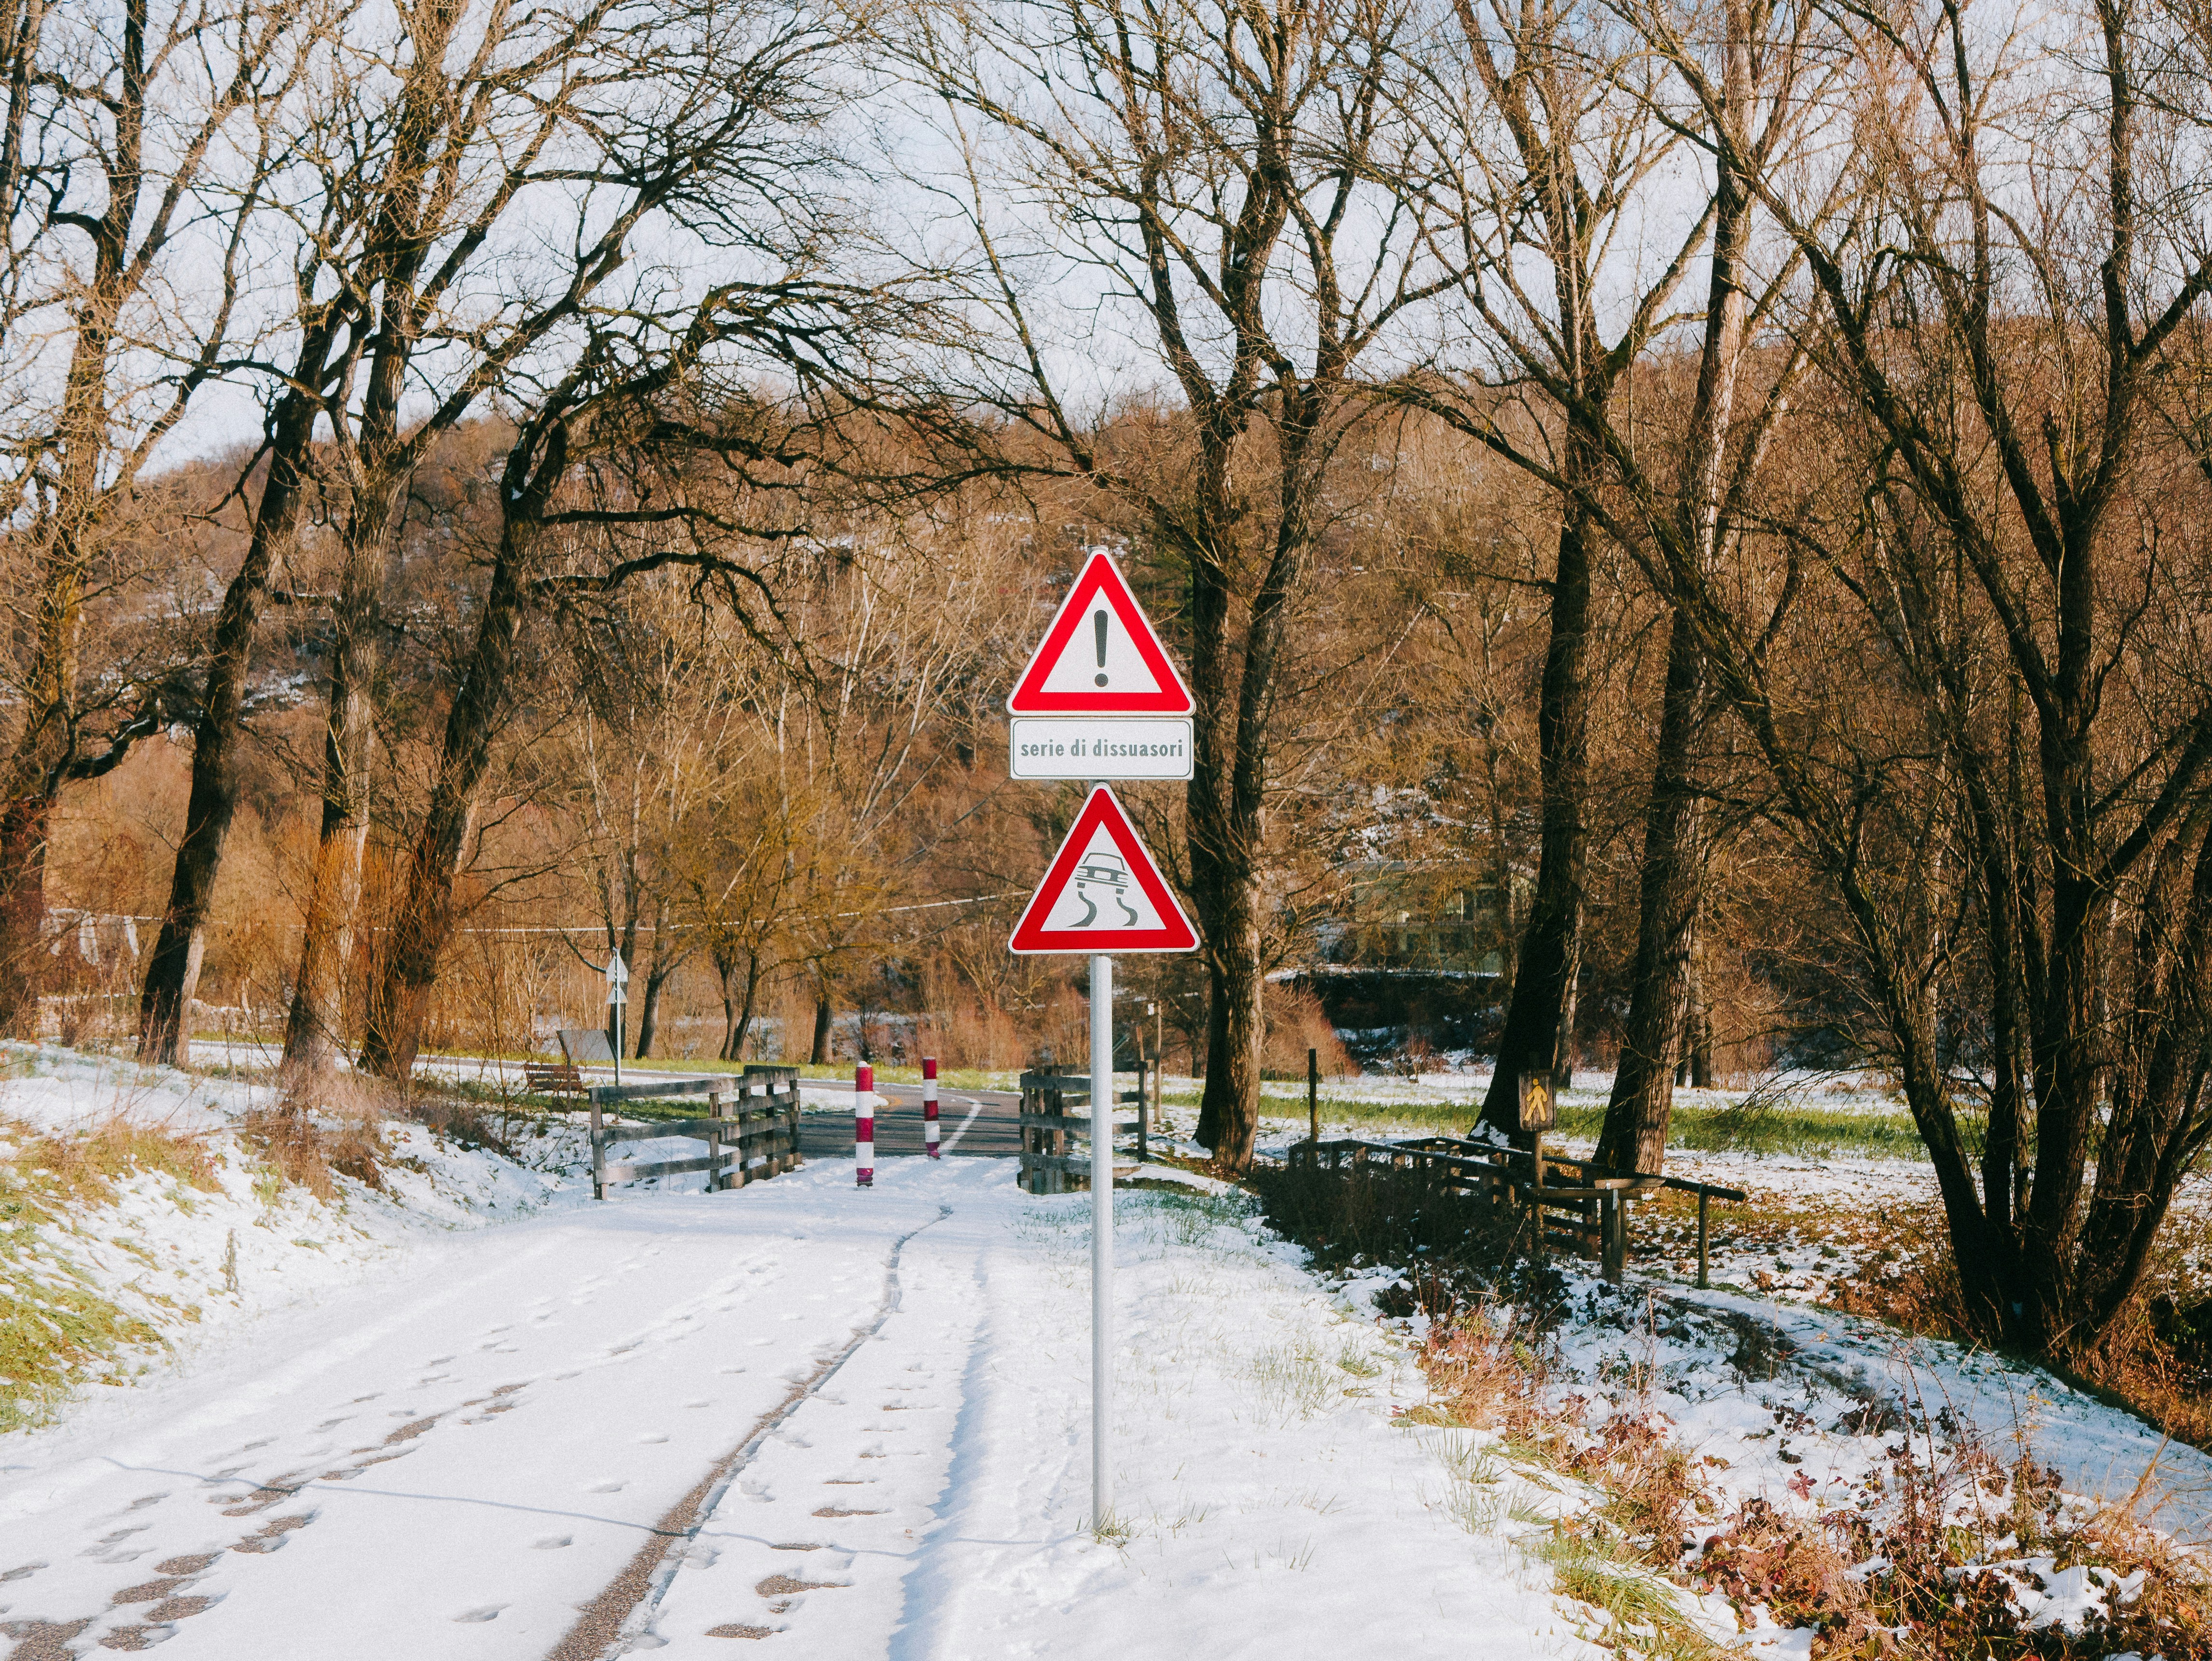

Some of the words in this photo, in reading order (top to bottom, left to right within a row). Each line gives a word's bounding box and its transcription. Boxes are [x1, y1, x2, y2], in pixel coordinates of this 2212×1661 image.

[1020, 739, 1064, 757] serie
[1071, 738, 1086, 757] di
[1093, 738, 1183, 757] dissuasori
